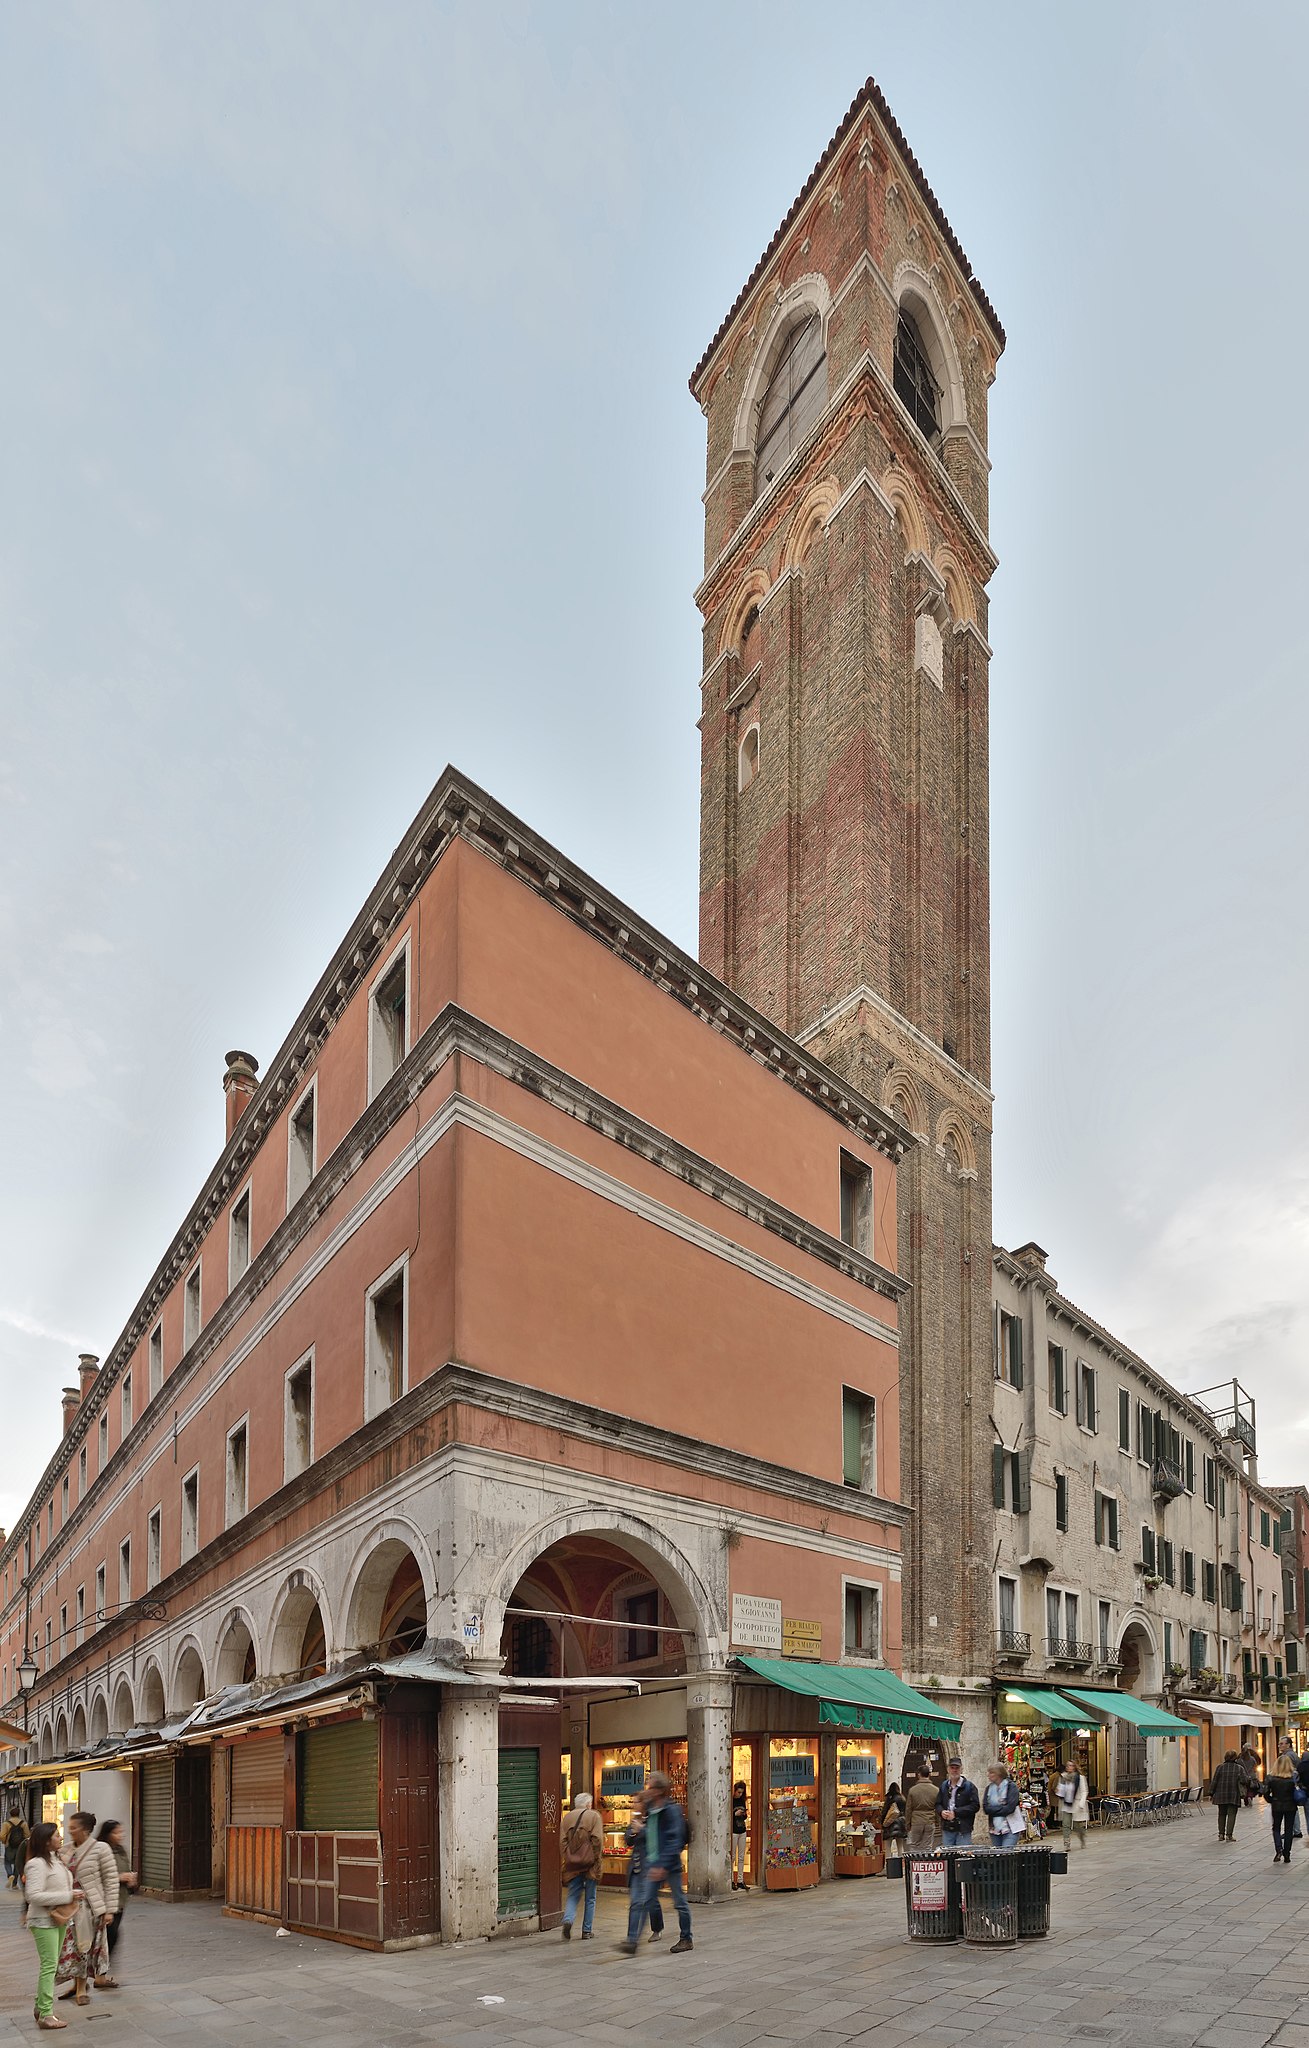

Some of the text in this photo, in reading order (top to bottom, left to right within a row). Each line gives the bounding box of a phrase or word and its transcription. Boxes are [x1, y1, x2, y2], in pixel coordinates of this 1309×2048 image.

[735, 1597, 780, 1611] RUGA VECCHIA
[733, 1621, 780, 1633] SOTOPORTEGO
[798, 1622, 819, 1630] RIALTO
[463, 1627, 478, 1636] WC
[739, 1633, 776, 1643] DE RIALTO
[856, 1708, 937, 1734] Biancardi
[771, 1760, 784, 1771] OGGI
[786, 1760, 802, 1771] TUTTO
[912, 1862, 944, 1871] VIETATO
